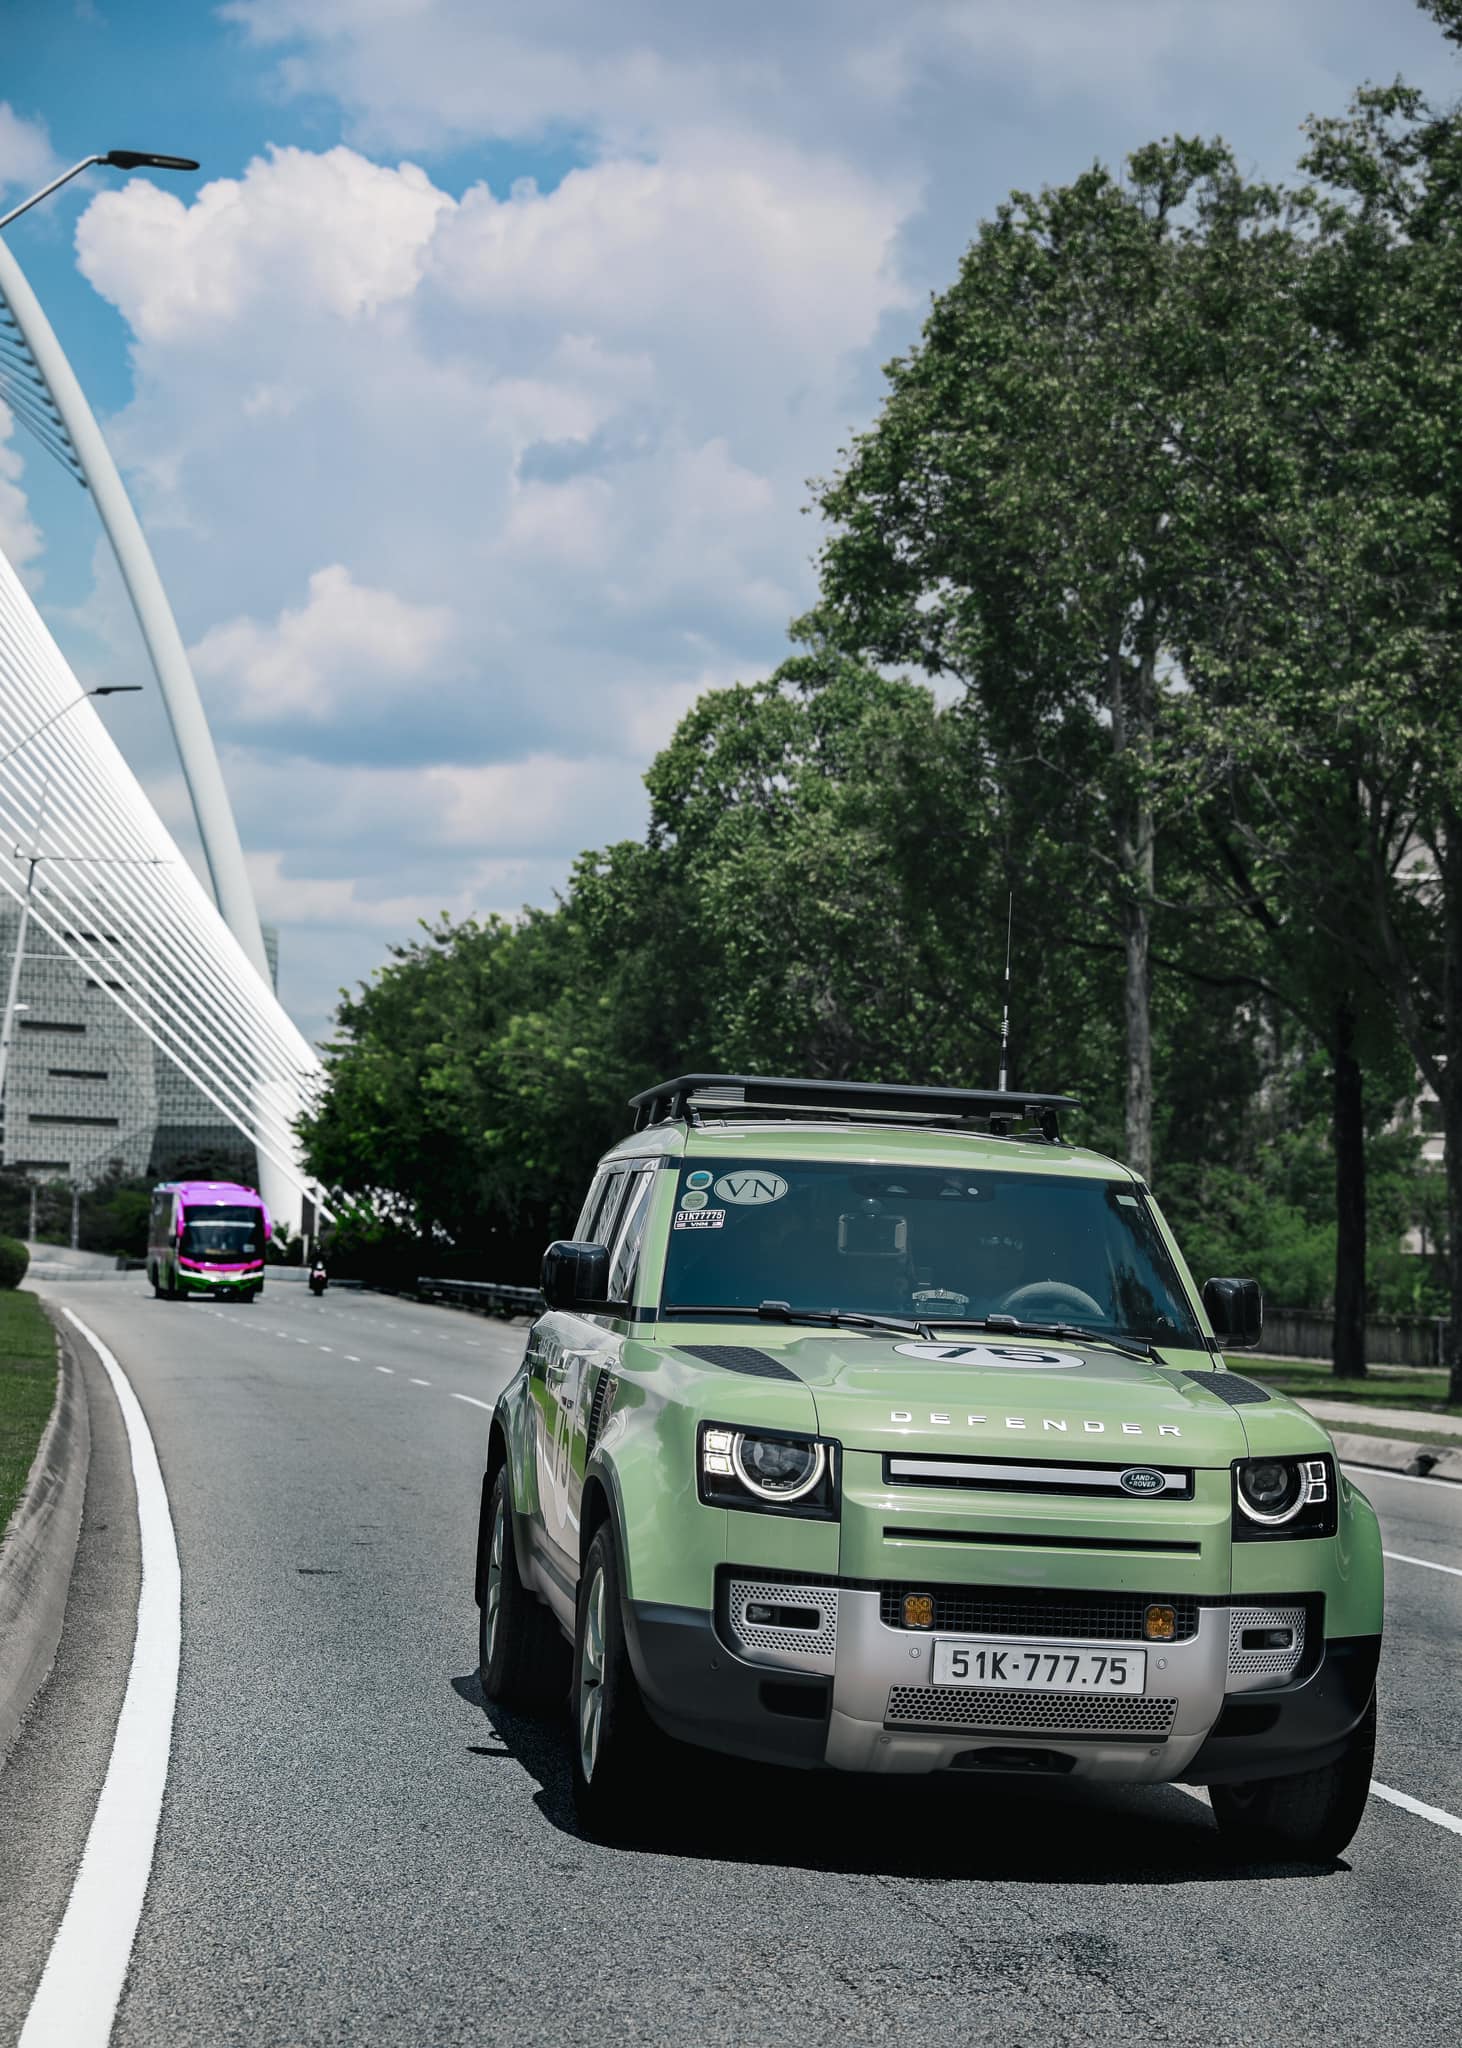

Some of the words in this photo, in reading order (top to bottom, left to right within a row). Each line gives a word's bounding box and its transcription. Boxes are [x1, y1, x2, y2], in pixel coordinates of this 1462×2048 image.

[725, 1179, 779, 1199] VN
[914, 1345, 1061, 1364] 75
[890, 1411, 1182, 1437] DEFENDER
[952, 1650, 1128, 1685] 51K-777.75
